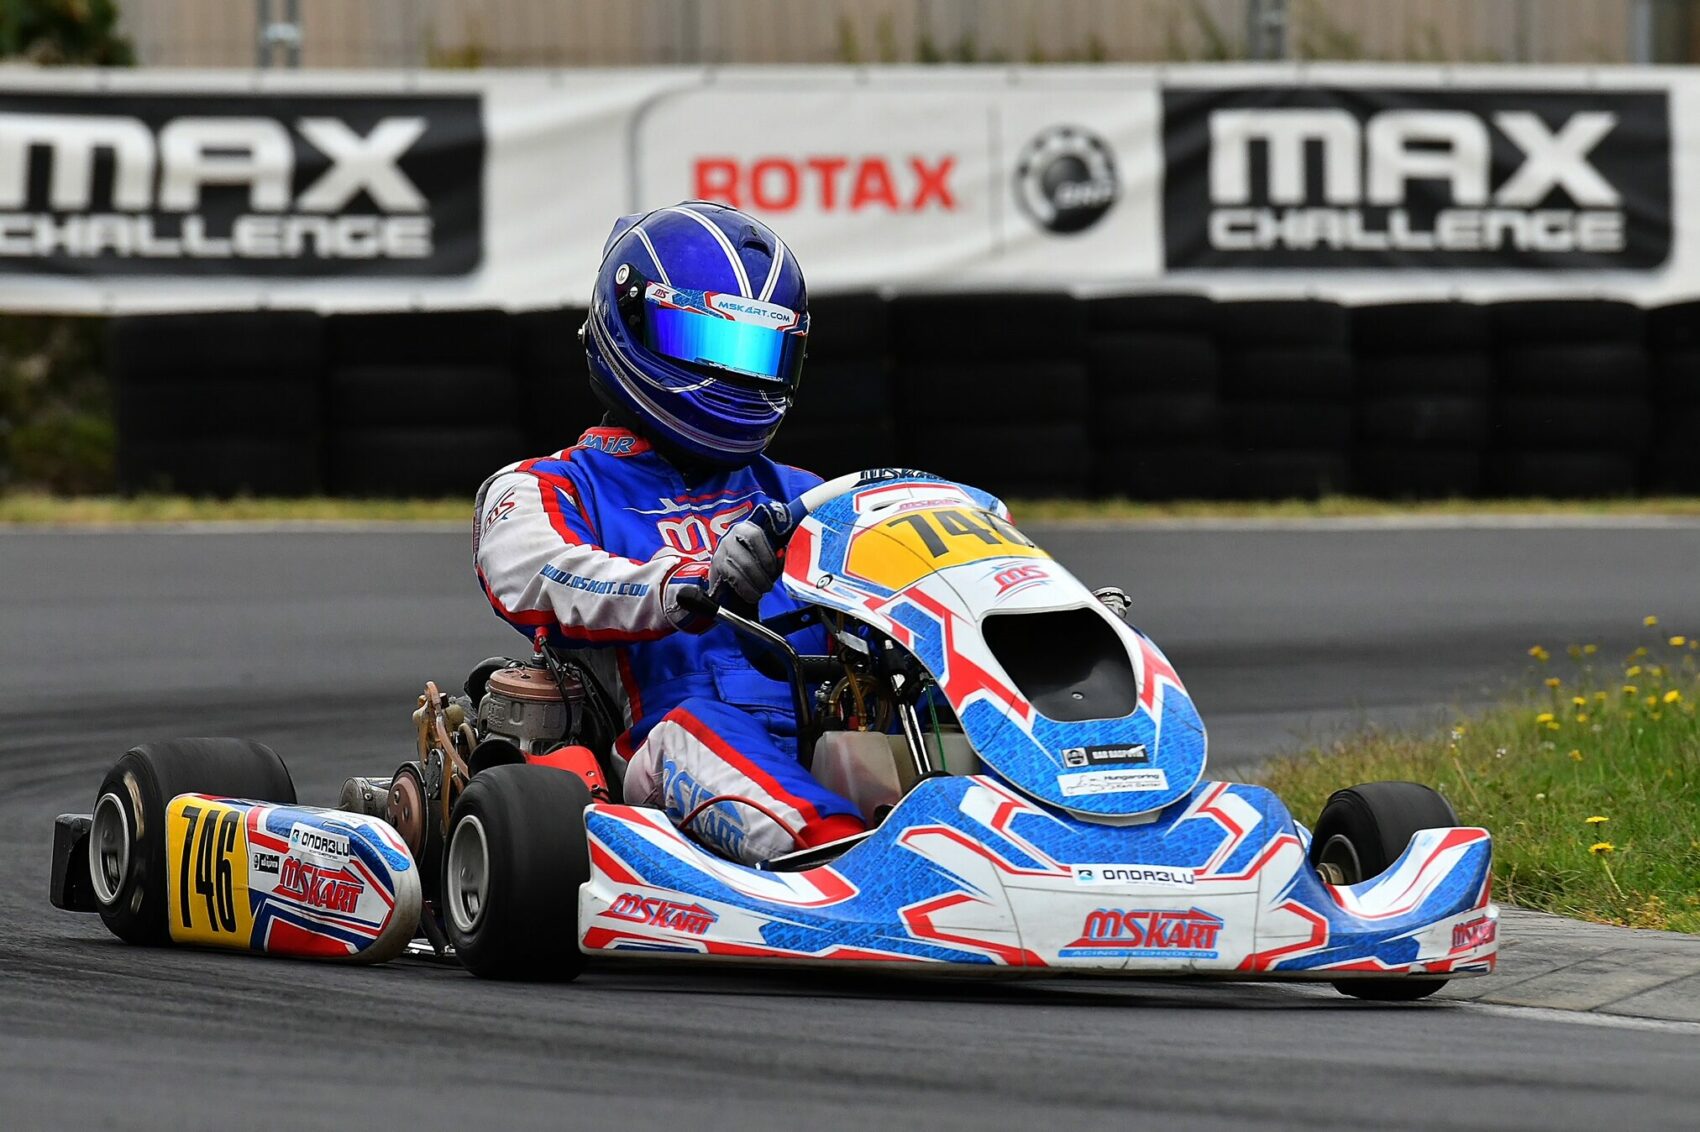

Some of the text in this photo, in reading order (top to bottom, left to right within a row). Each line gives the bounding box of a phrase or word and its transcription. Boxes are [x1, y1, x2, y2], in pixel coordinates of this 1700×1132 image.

[0, 113, 428, 211] MAX
[1210, 107, 1622, 207] MAX
[693, 153, 957, 213] ROTAX
[0, 214, 433, 259] CHALLENGE
[1209, 209, 1624, 252] CHALLENGE
[717, 300, 791, 323] MSKART.COM
[180, 805, 241, 933] 746
[272, 855, 365, 913] MSKART
[595, 892, 720, 935] MSKART
[1064, 906, 1224, 949] MSKART
[1068, 949, 1119, 957] ACING
